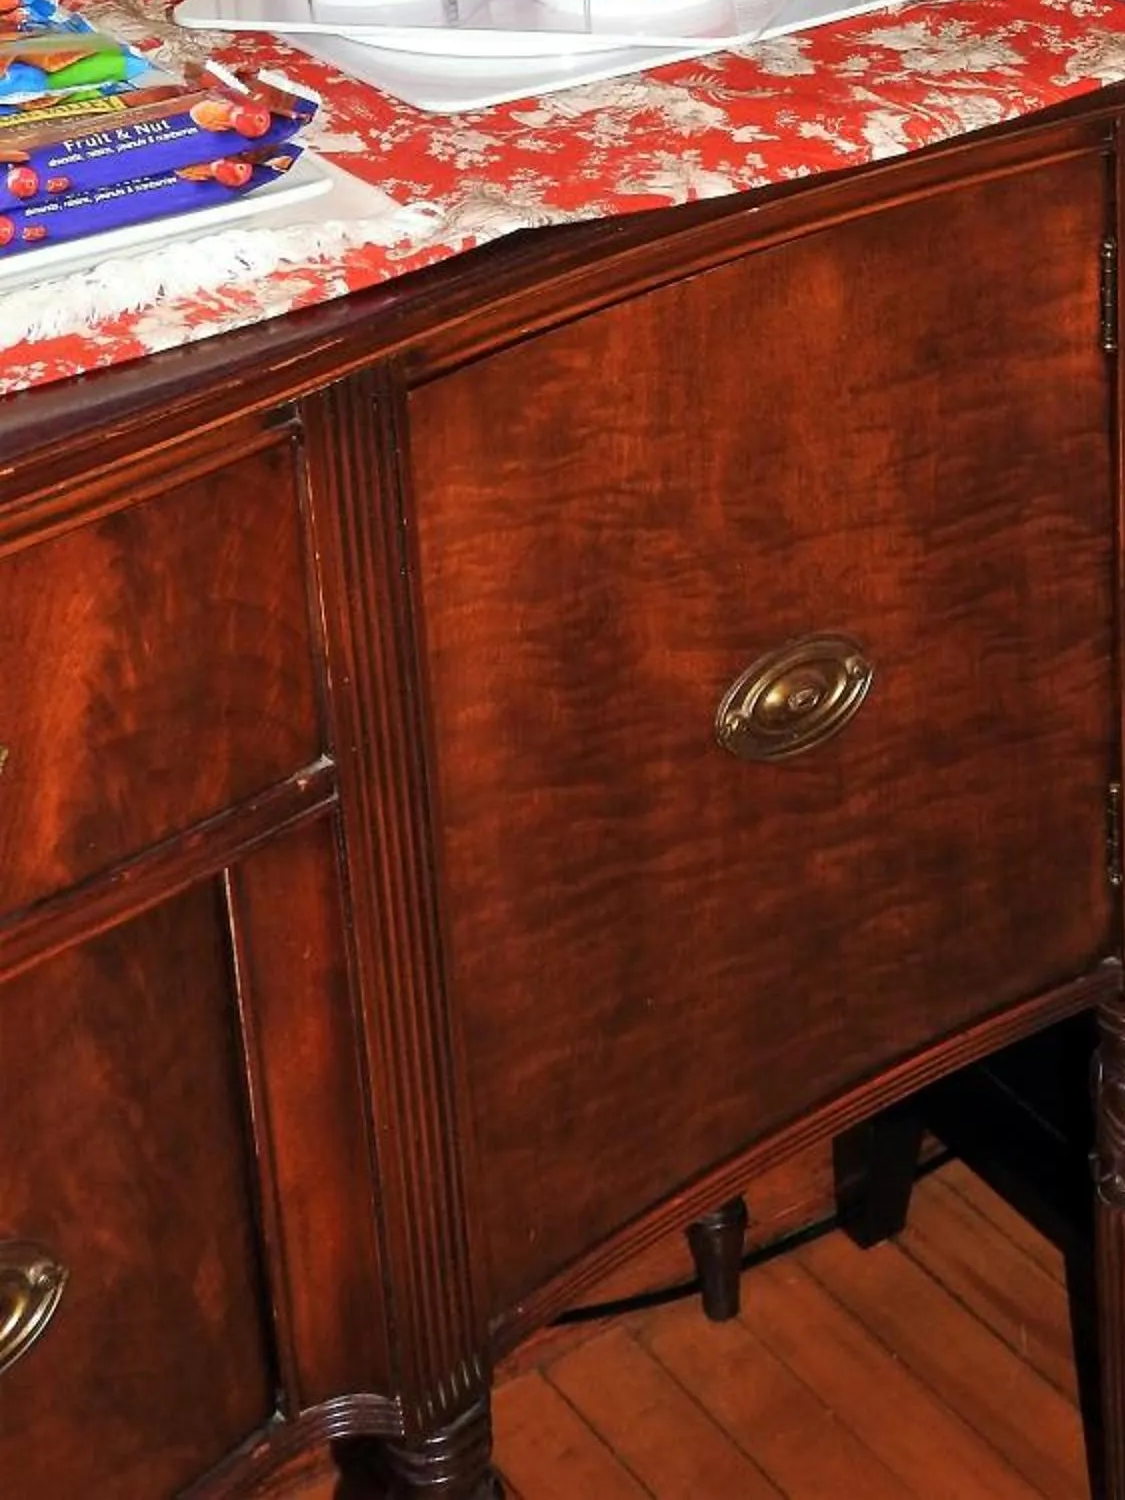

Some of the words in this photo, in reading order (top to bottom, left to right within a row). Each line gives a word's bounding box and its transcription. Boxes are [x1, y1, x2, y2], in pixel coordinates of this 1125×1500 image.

[63, 132, 112, 152] Fruit
[116, 129, 132, 140] &
[134, 119, 172, 136] Nut
